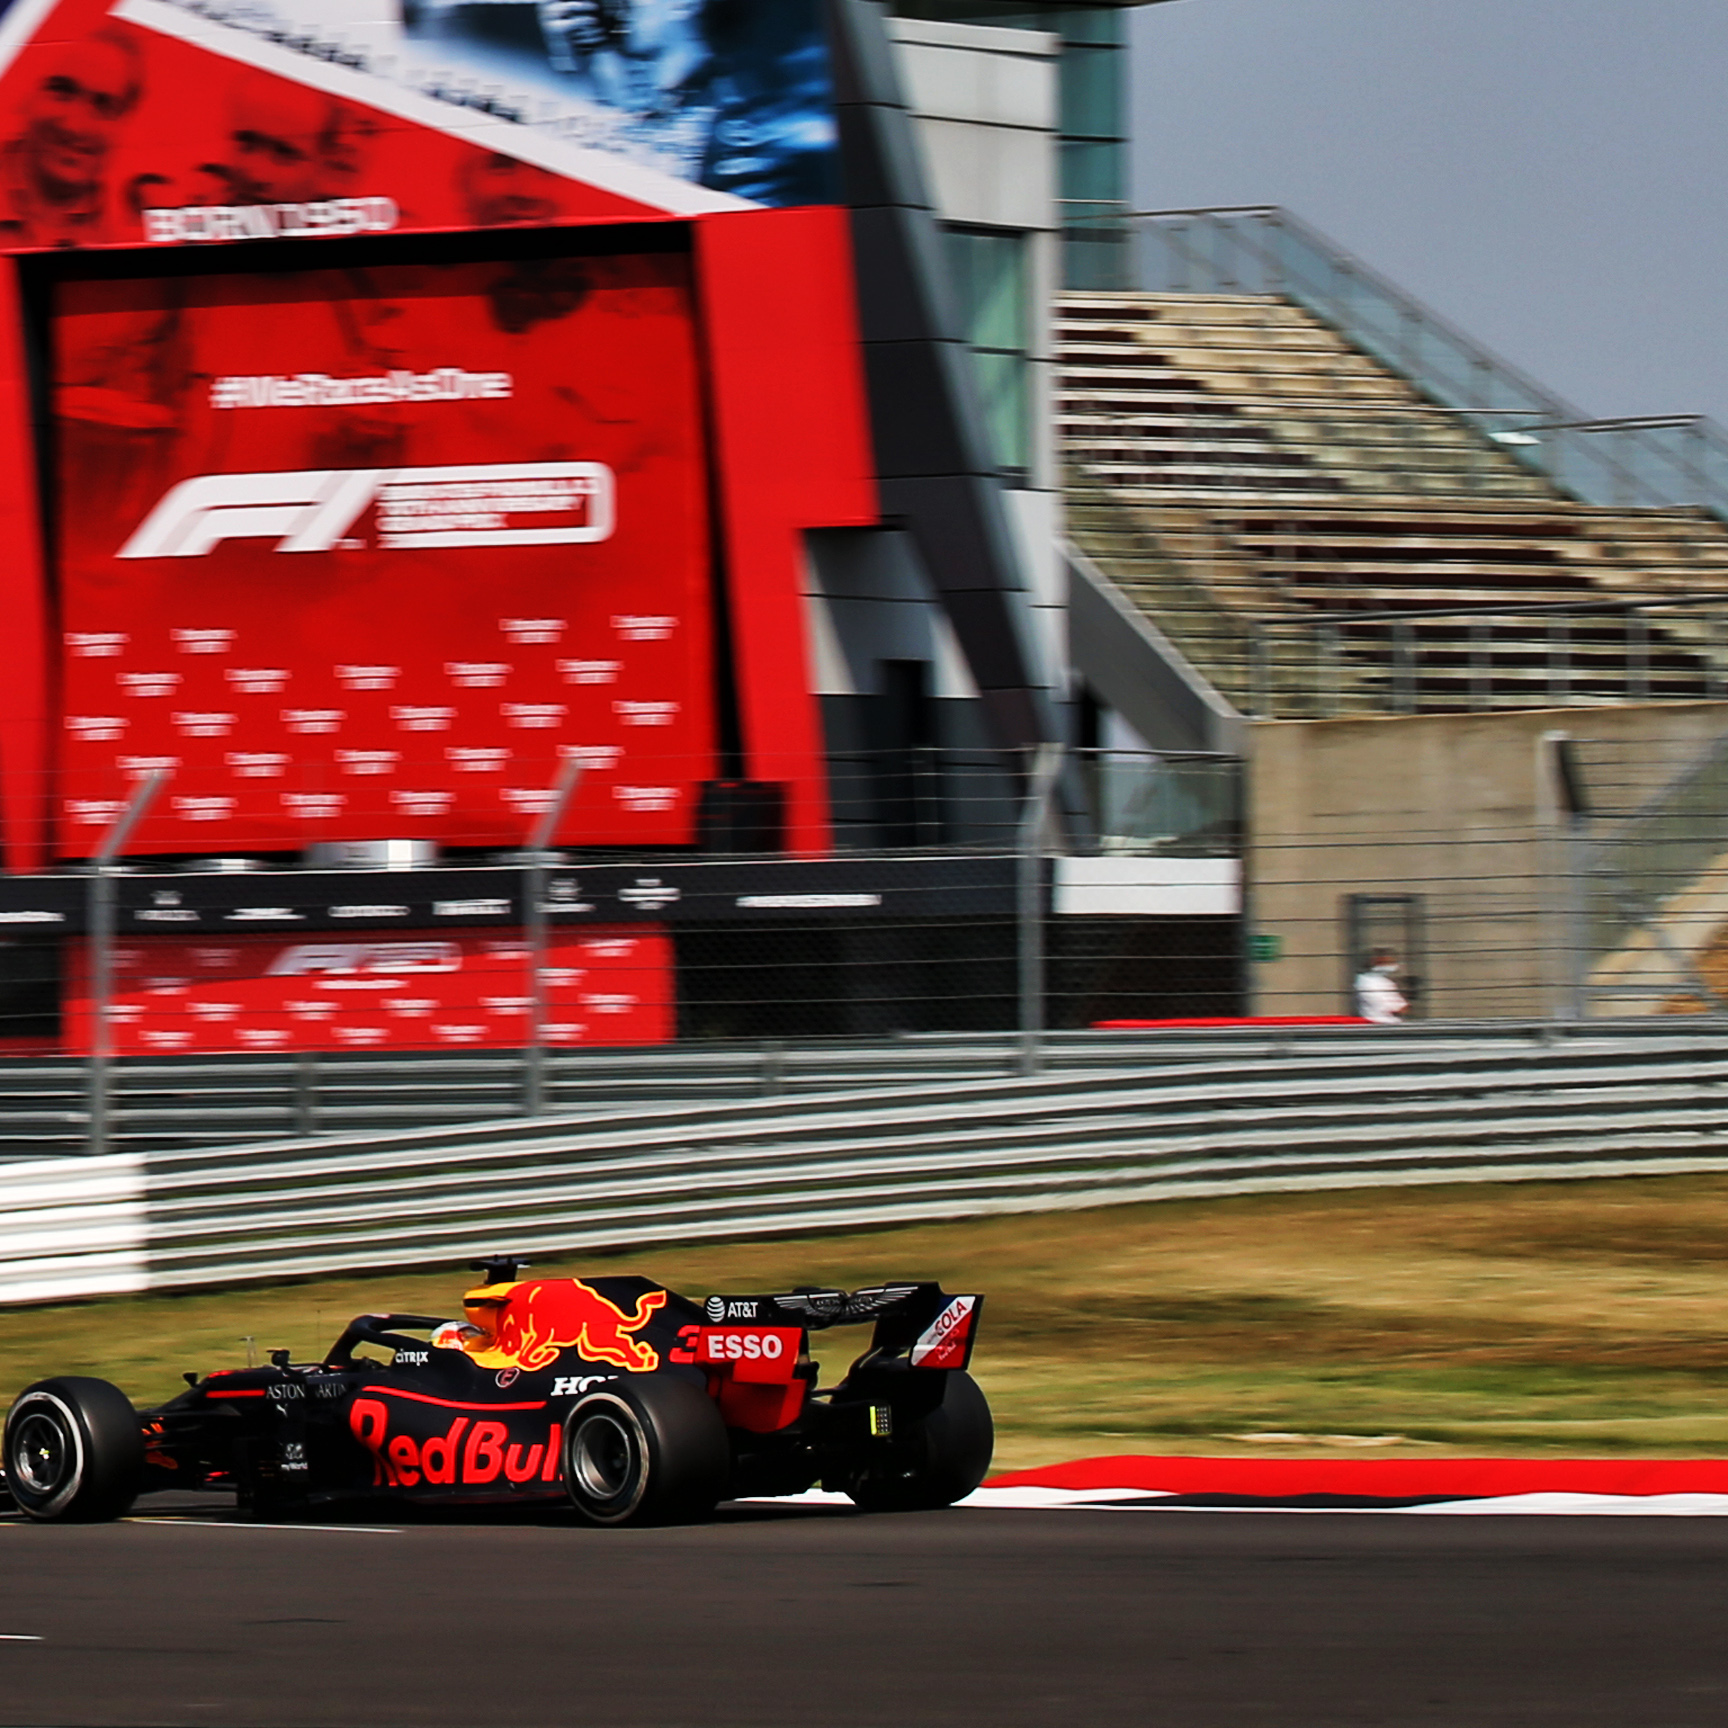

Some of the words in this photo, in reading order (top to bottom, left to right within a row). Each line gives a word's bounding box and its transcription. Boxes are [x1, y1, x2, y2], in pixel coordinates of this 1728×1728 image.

[728, 1301, 759, 1318] AT&T
[935, 1301, 967, 1336] COLA
[707, 1334, 783, 1359] ESSO
[266, 1384, 305, 1399] ASTON
